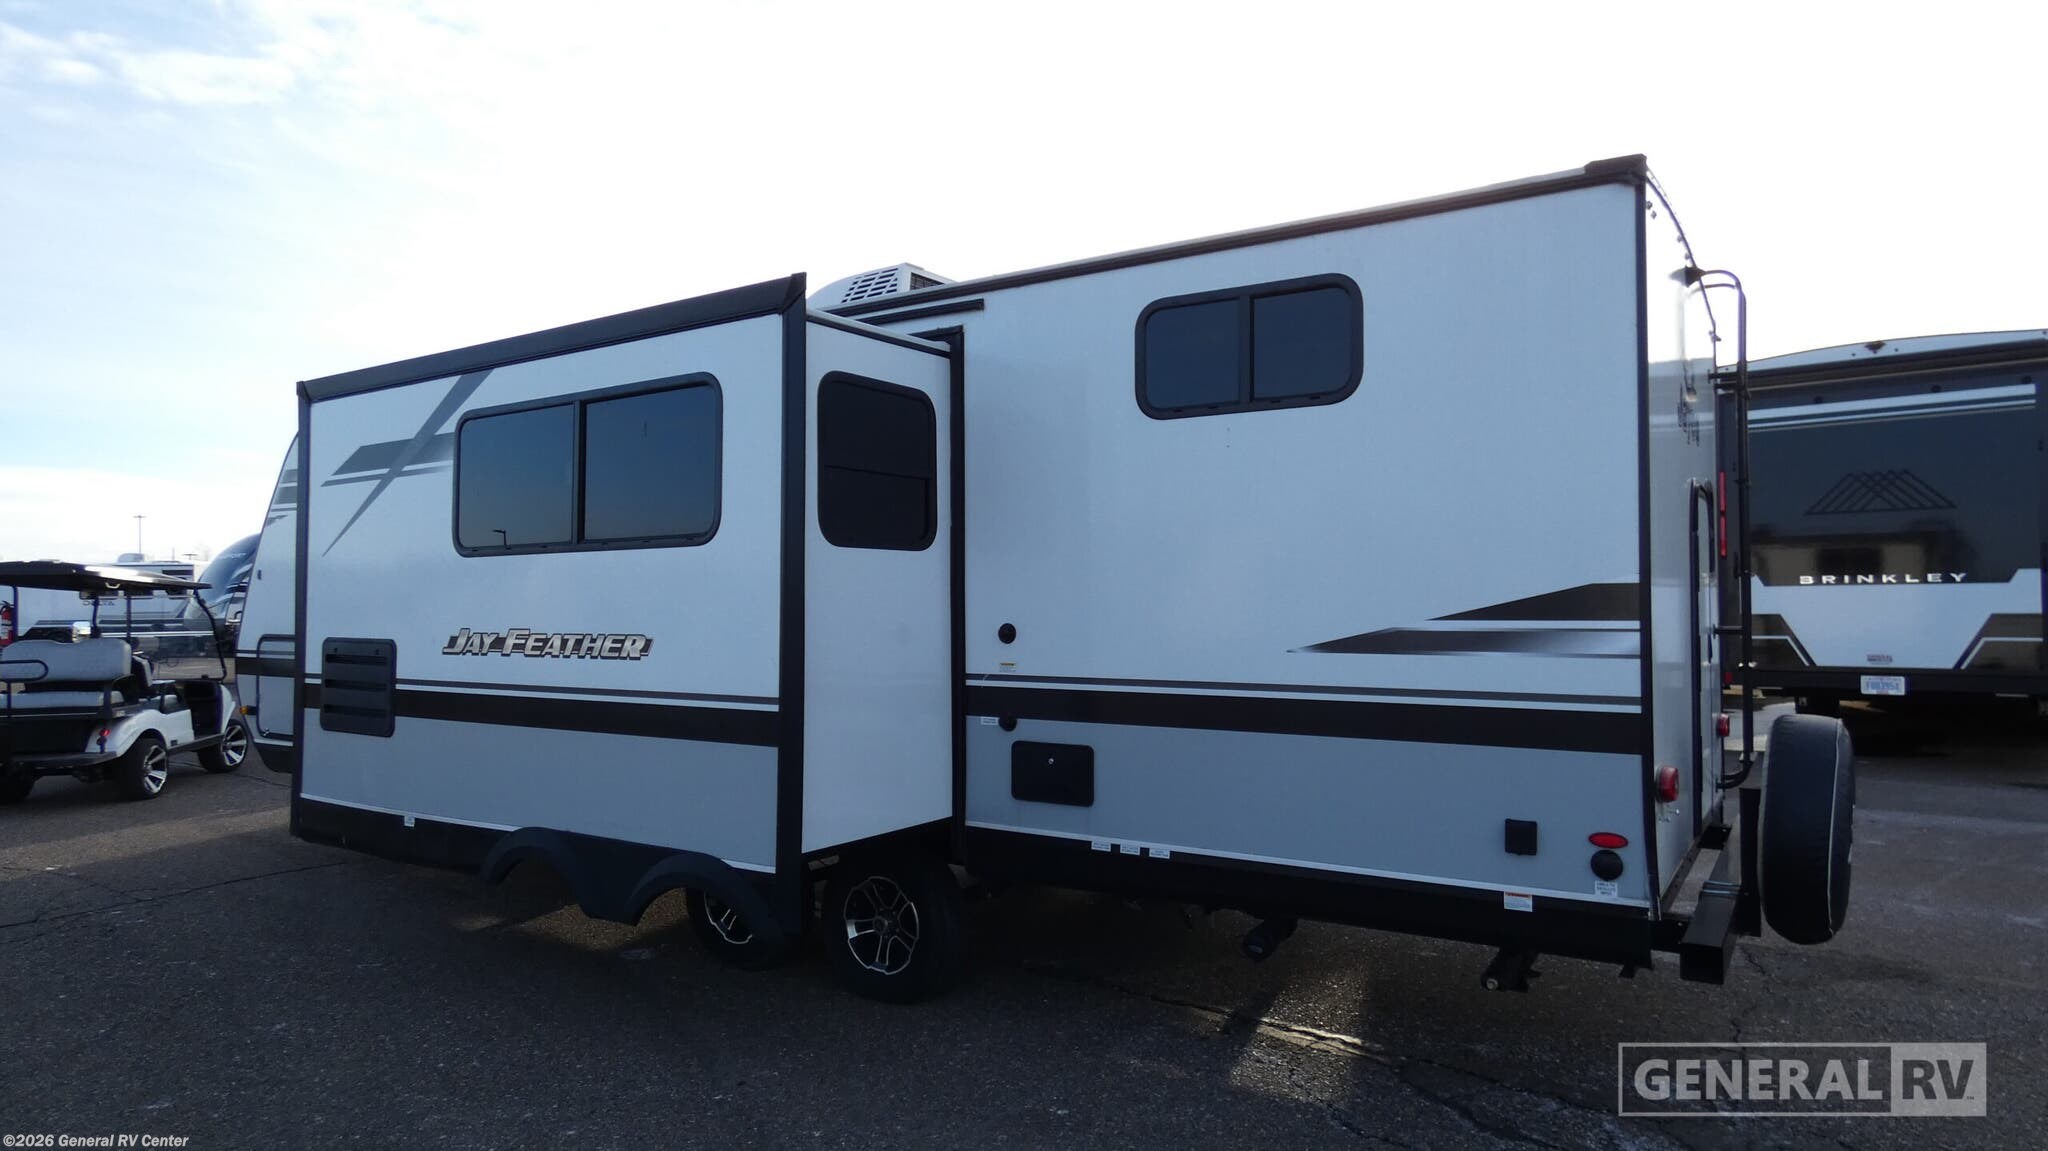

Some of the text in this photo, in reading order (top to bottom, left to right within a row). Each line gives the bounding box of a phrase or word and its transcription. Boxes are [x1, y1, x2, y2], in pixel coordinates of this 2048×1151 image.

[1800, 573, 1966, 584] BRINKLEY
[442, 628, 646, 660] JAY FEATHER
